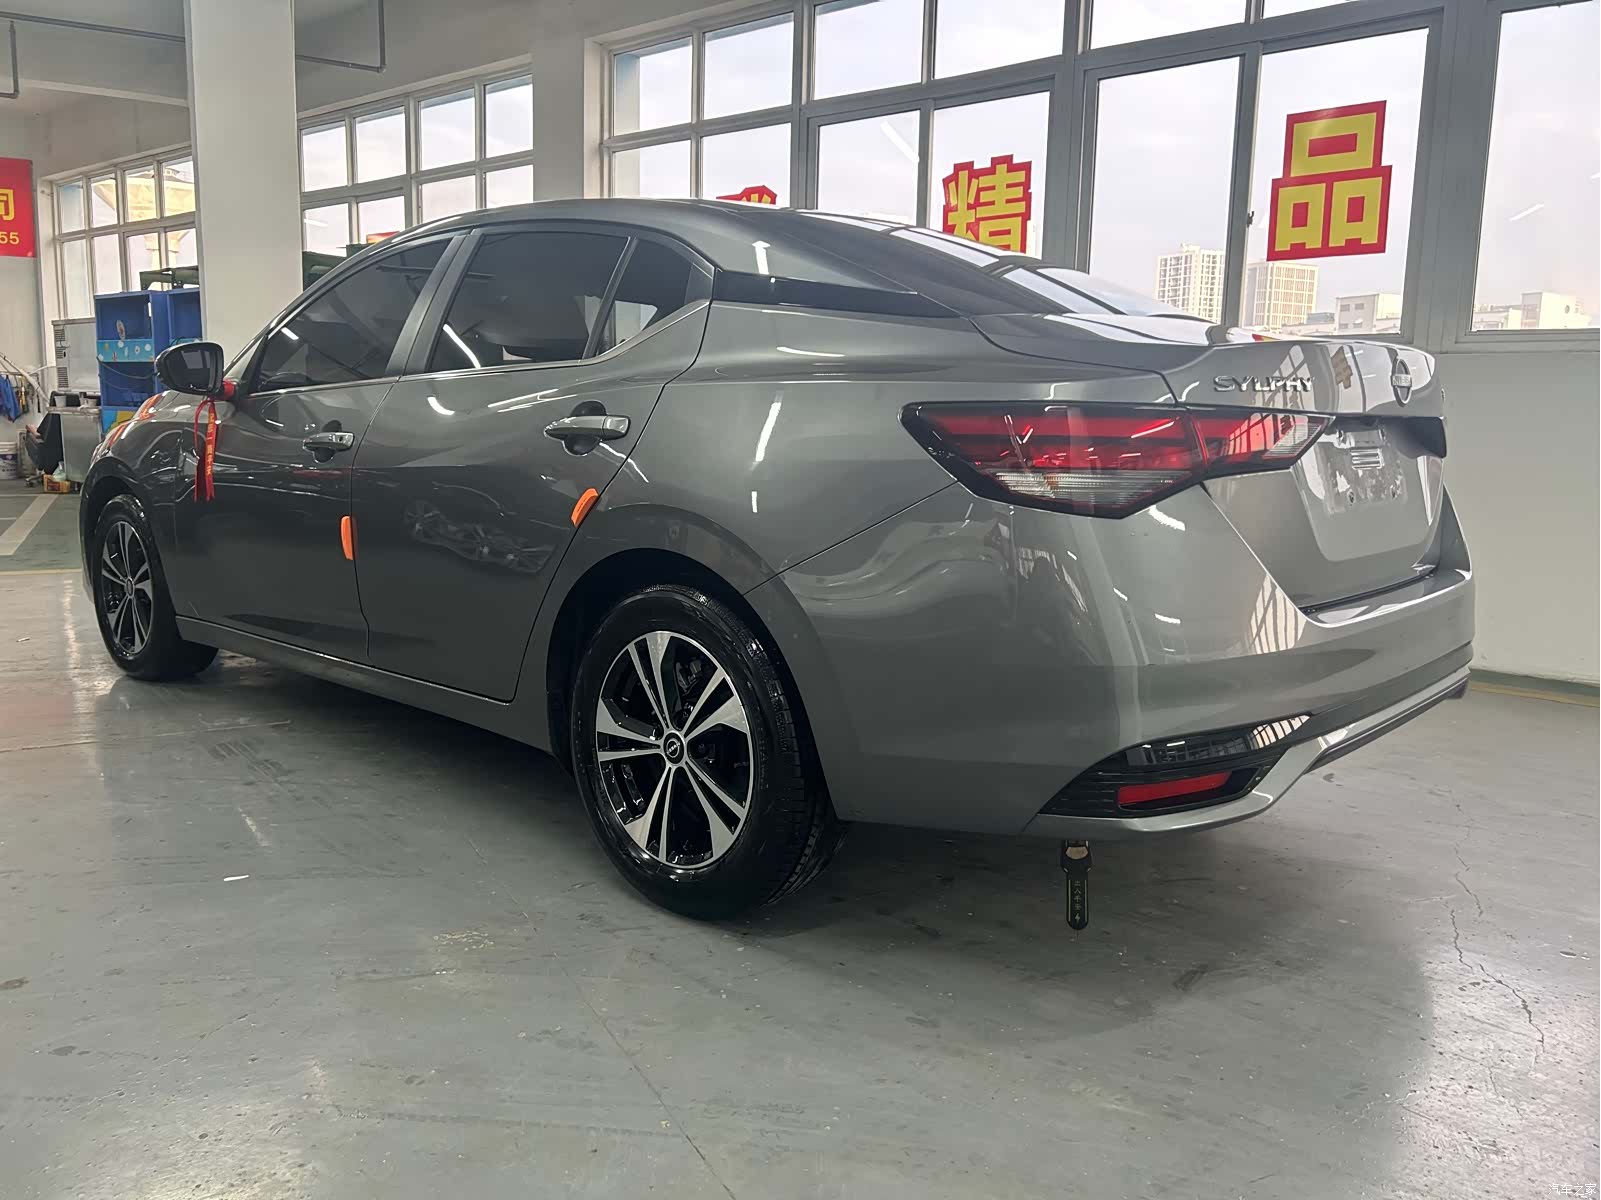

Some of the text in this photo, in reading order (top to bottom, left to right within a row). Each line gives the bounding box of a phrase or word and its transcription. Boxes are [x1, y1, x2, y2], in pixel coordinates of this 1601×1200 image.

[945, 108, 1386, 254] 精 品
[1214, 376, 1315, 392] SYLPHY
